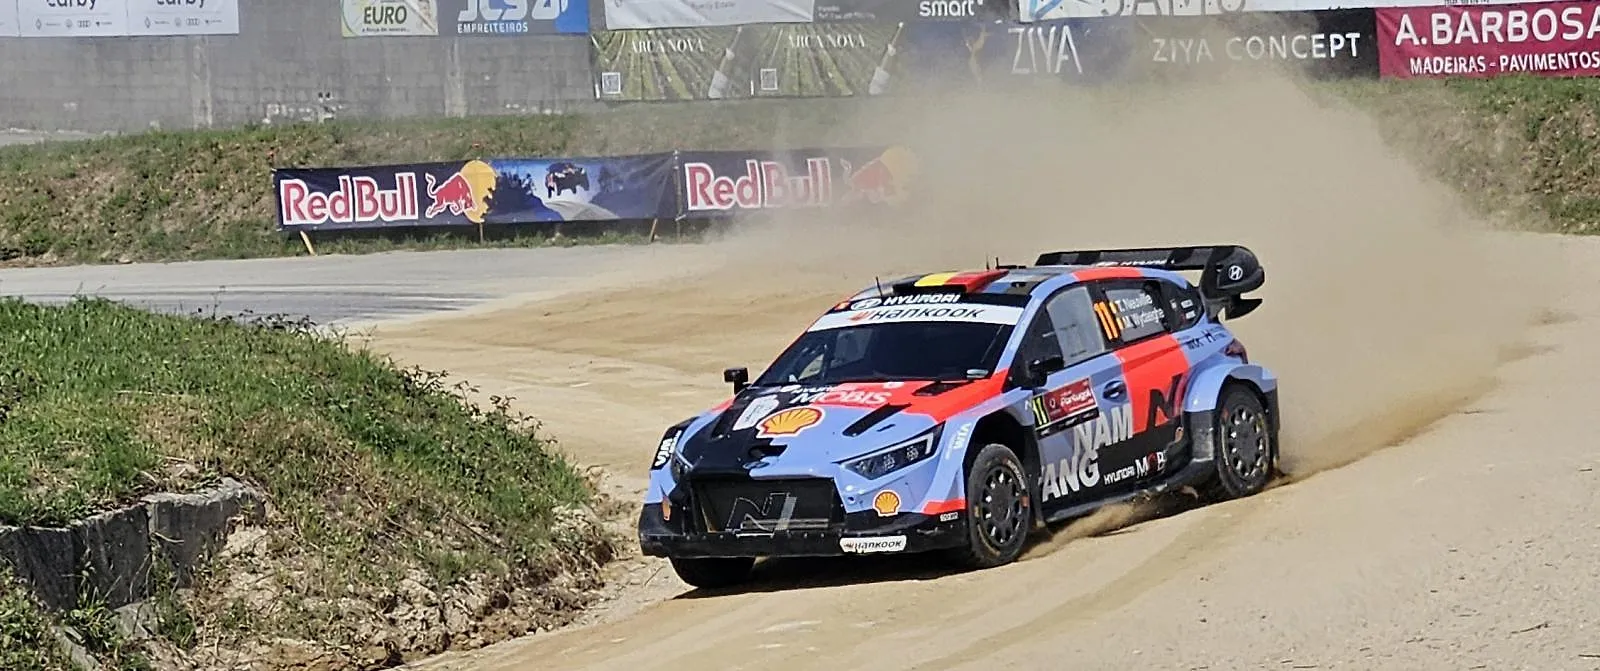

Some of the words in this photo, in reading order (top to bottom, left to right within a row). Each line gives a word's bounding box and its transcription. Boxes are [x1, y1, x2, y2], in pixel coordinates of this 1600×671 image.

[364, 6, 407, 24] EURO
[919, 0, 975, 17] smart
[457, 22, 528, 34] EMPREITEIROS
[668, 37, 704, 53] NOVA
[827, 33, 865, 49] NOVA
[1008, 25, 1083, 74] ZIYA
[1152, 38, 1213, 63] ZIYA
[1226, 33, 1360, 61] CONCEPT
[1410, 56, 1486, 74] MADEIRAS
[1500, 52, 1600, 72] PAVIMENTOS
[686, 159, 761, 210] Red
[761, 158, 831, 208] Bull
[281, 175, 353, 225] Red
[353, 173, 419, 222] Bull
[884, 294, 961, 306] HYUNDAI
[870, 308, 985, 320] Hankook
[1093, 301, 1118, 341] 11
[790, 391, 892, 405] MOBIS
[1074, 403, 1134, 457] NAM
